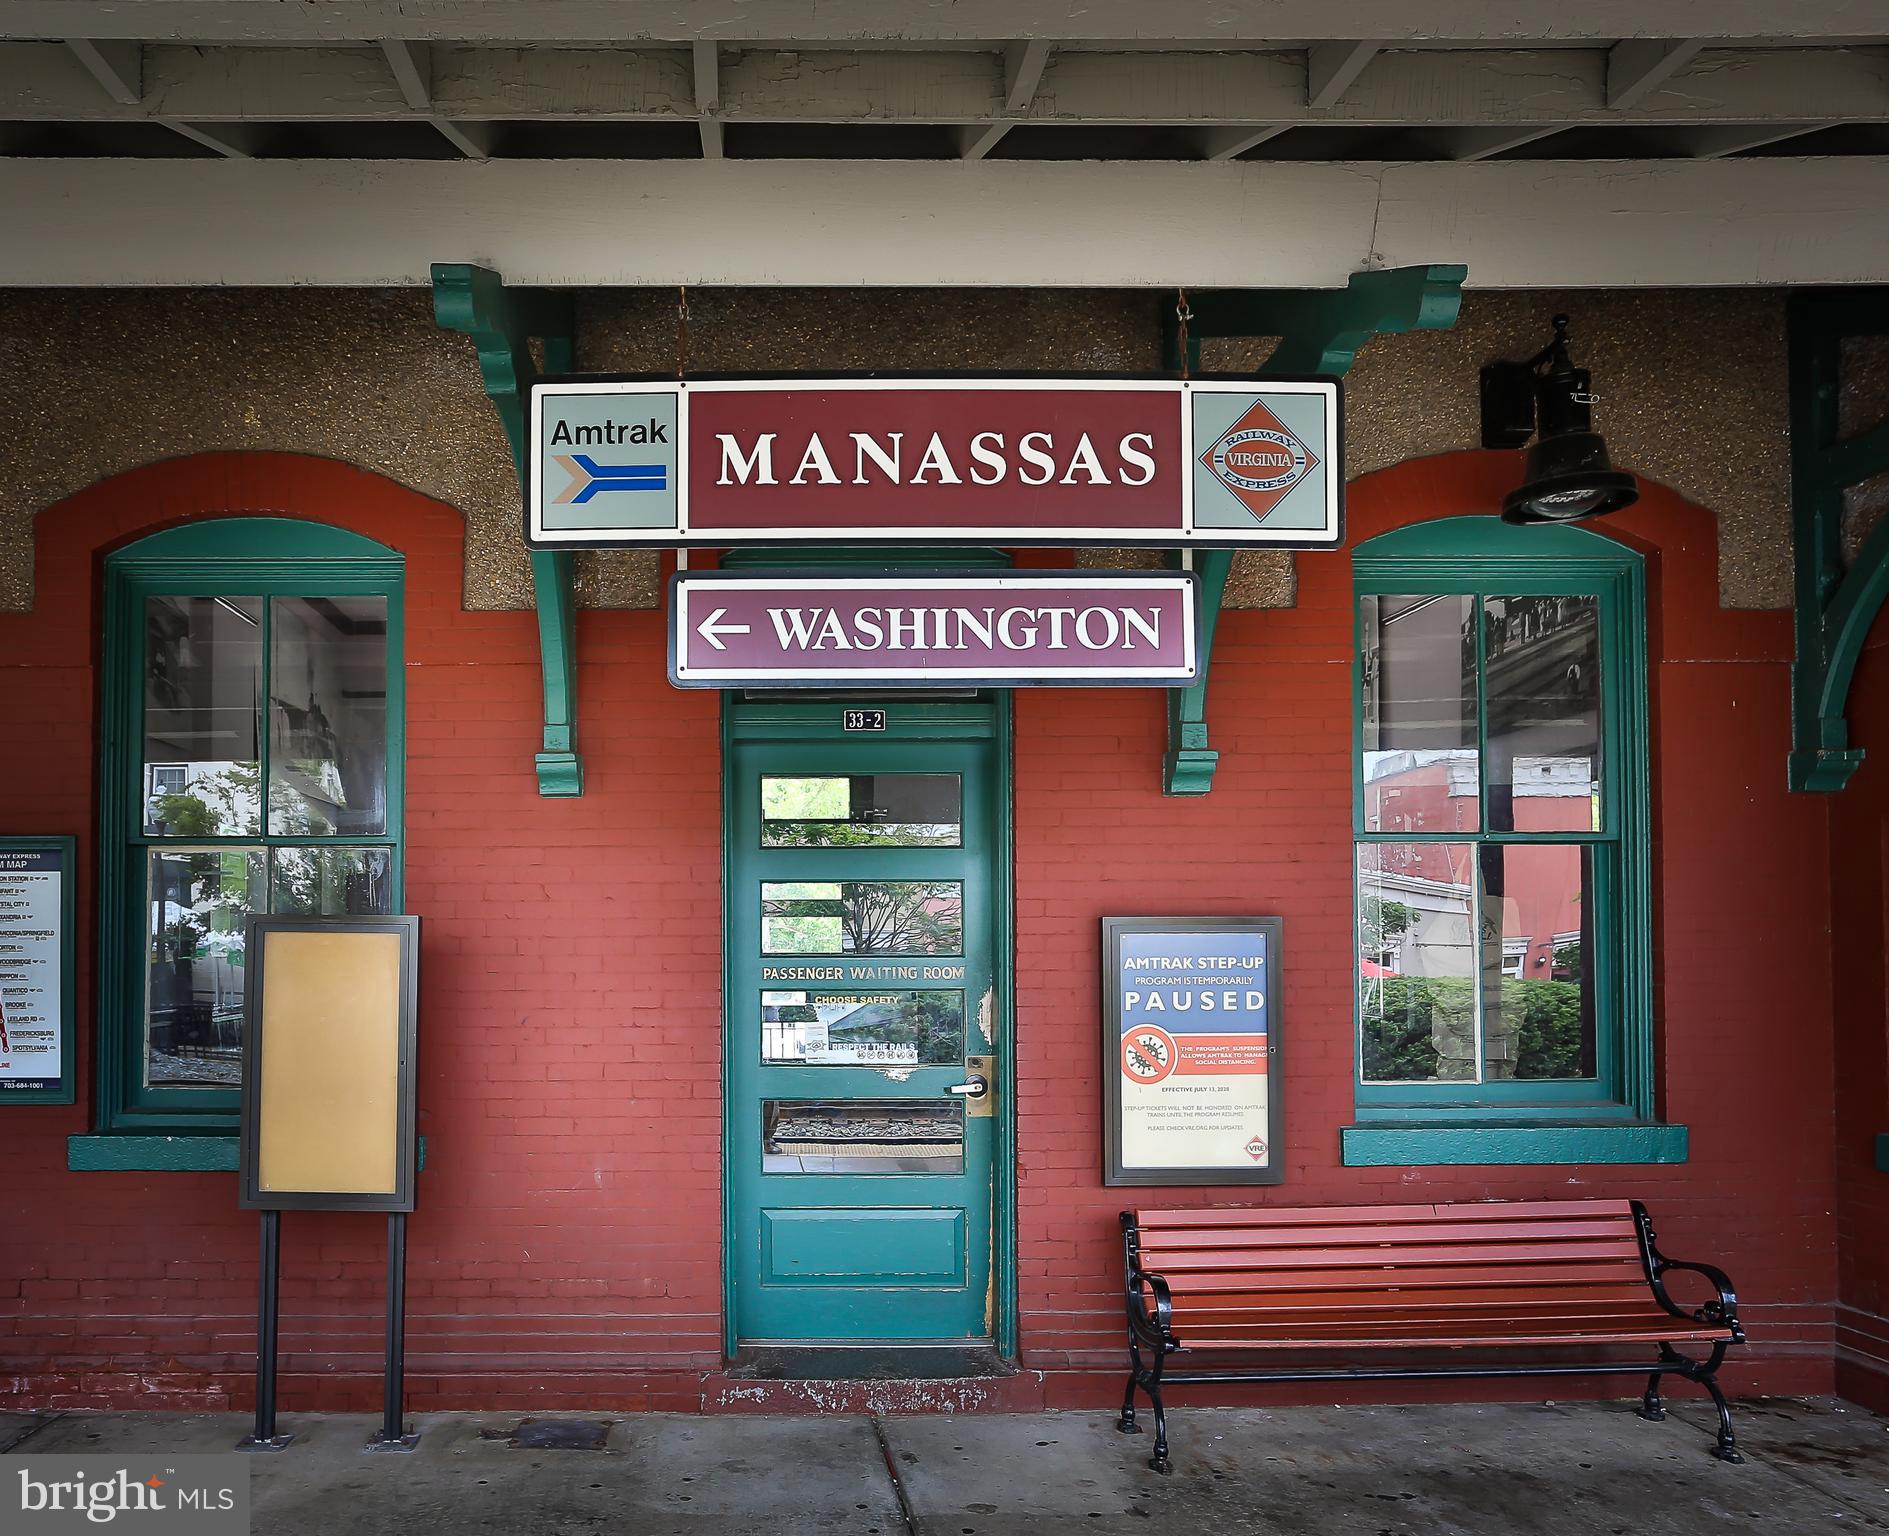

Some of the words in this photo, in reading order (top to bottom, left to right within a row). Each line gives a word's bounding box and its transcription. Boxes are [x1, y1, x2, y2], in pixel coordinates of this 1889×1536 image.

[551, 418, 668, 445] Amtrak
[1226, 431, 1296, 447] RAILWAY
[715, 431, 1157, 486] MANASSAS
[1227, 453, 1292, 467] VIRGINIA
[1223, 471, 1296, 488] EXPRESS
[766, 606, 1162, 651] WASHINGTON
[849, 712, 881, 728] 33-2
[1124, 957, 1193, 969] AMTRAK
[1198, 957, 1264, 969] STEP-UP
[763, 967, 844, 980] PASSENGER
[849, 967, 918, 980] WAITING
[923, 966, 965, 979] ROOM
[1135, 977, 1182, 985] PROGRAM
[1184, 977, 1191, 985] IS
[1193, 977, 1254, 985] TEMPORARILY
[815, 996, 857, 1004] CHOOSE
[860, 996, 899, 1004] SAFETY
[1125, 991, 1265, 1011] PAUSED
